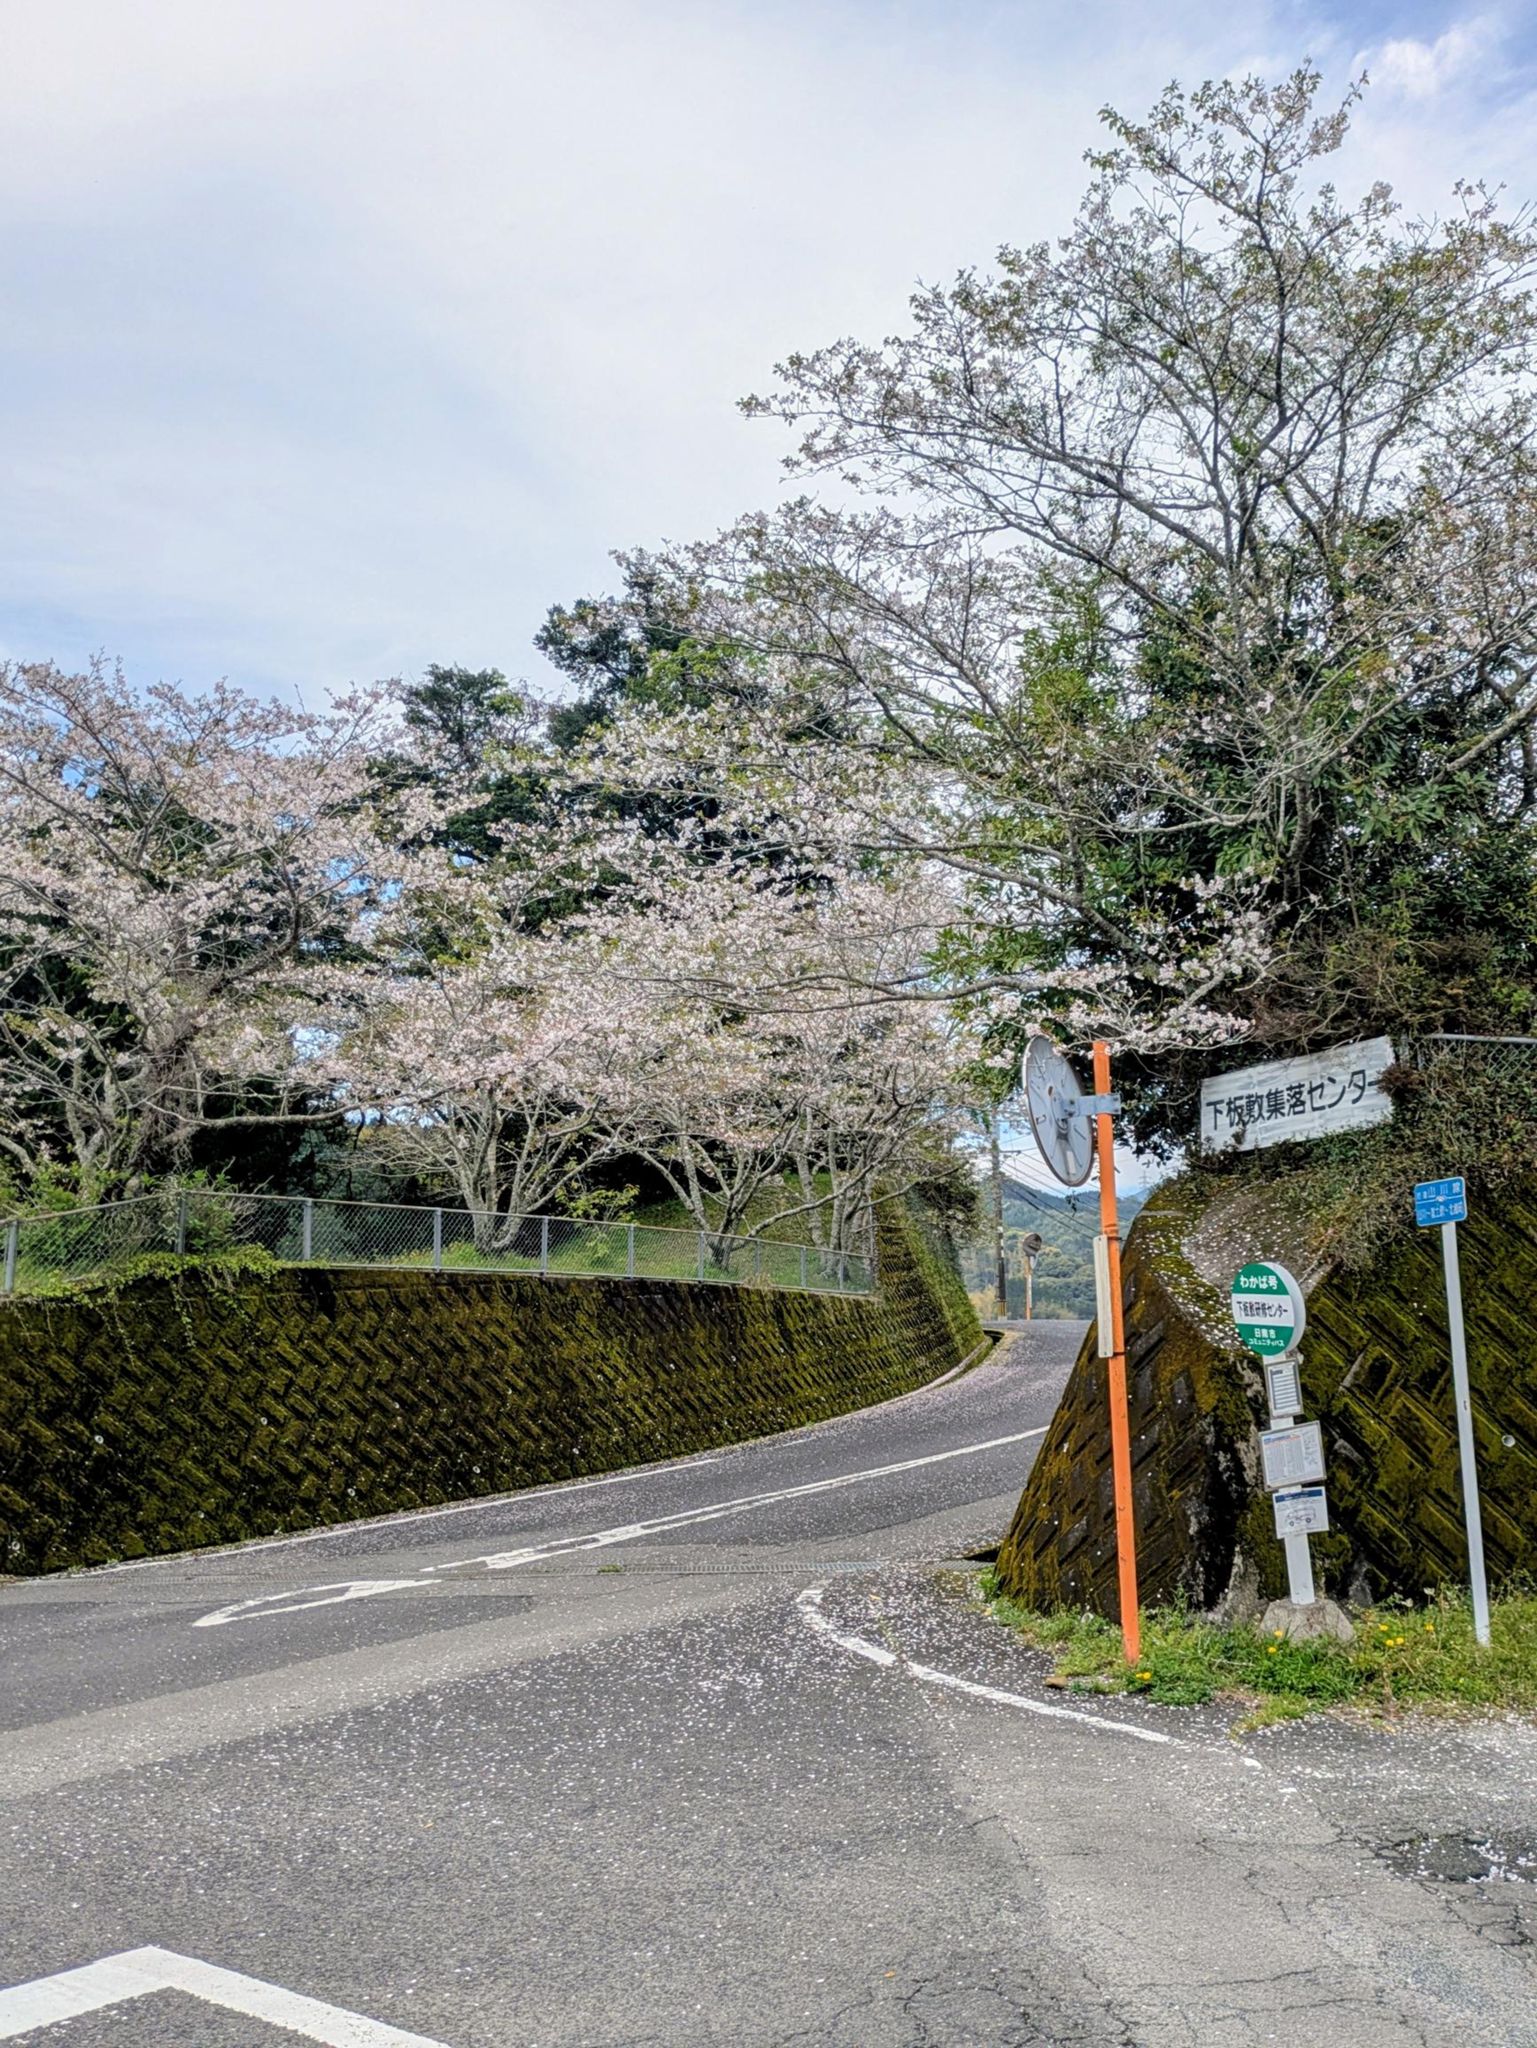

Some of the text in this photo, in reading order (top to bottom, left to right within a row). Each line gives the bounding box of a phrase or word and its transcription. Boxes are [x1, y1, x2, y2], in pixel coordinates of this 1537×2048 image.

[1206, 1069, 1380, 1130] 下板敷集落センター
[1239, 1275, 1278, 1290] わかば号
[1248, 1338, 1285, 1348] コミュニティバス
